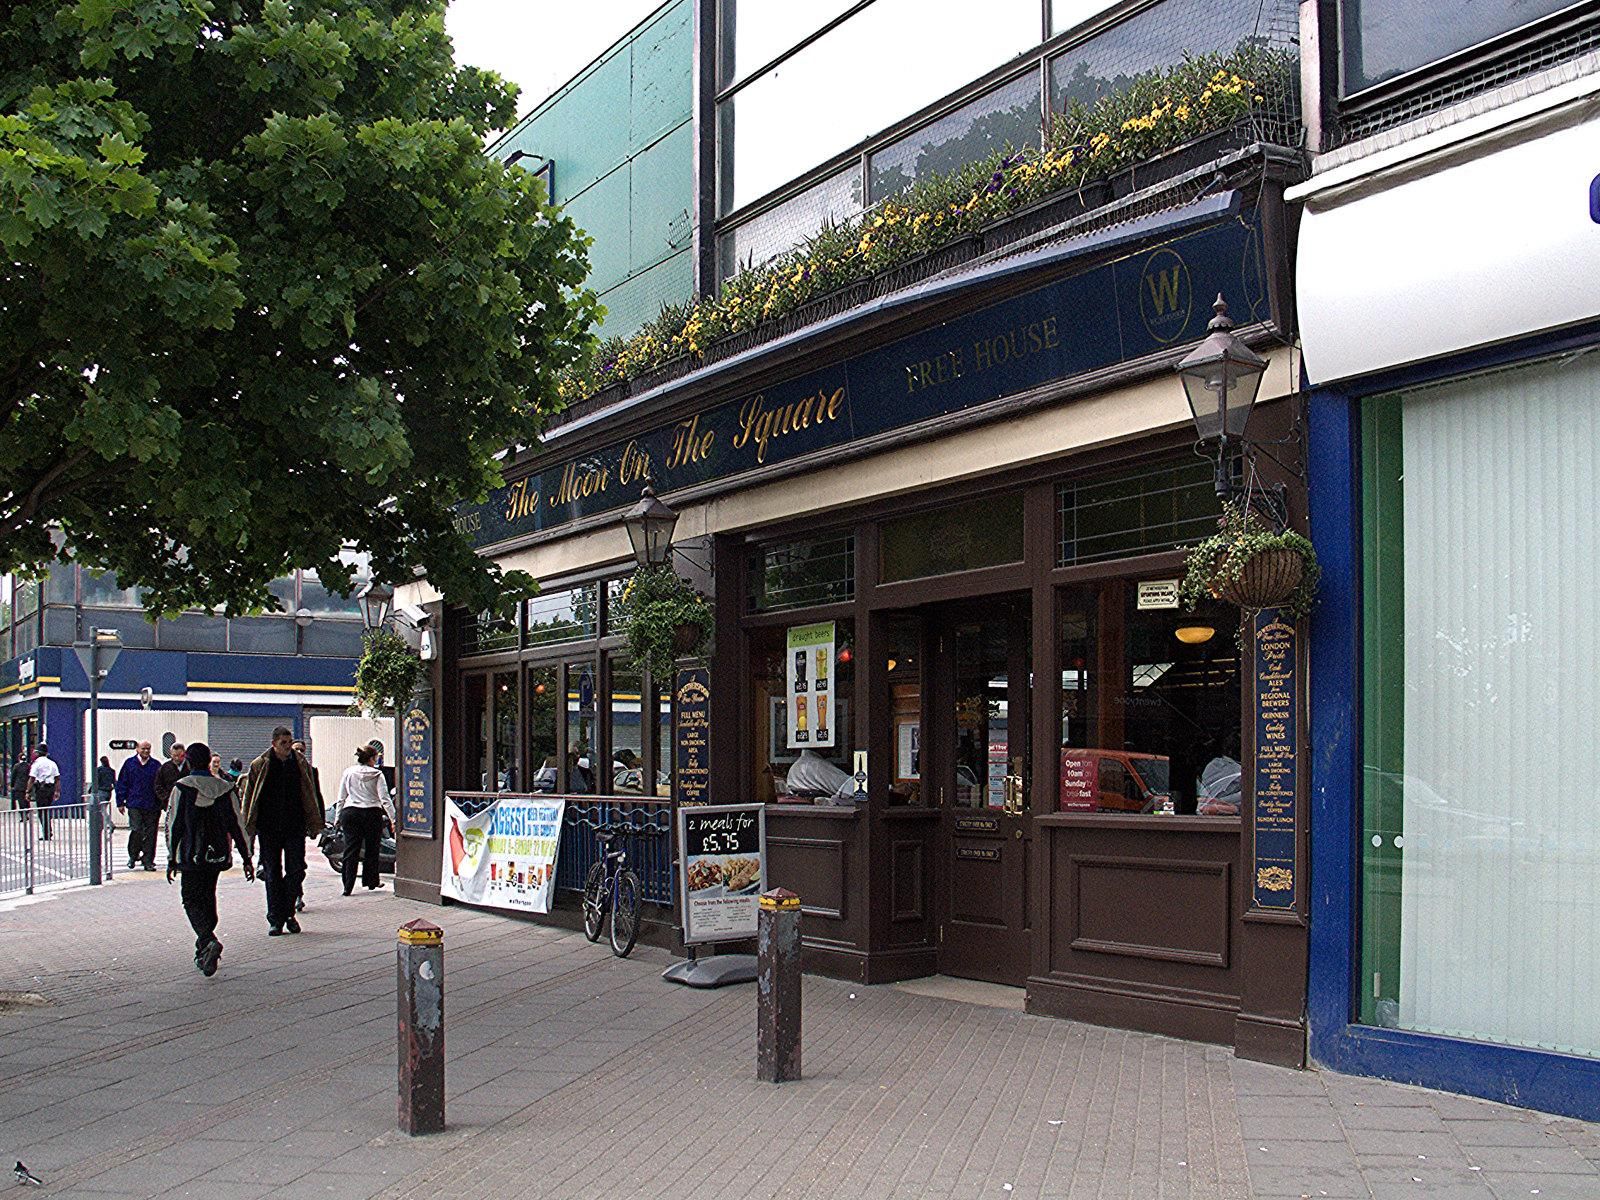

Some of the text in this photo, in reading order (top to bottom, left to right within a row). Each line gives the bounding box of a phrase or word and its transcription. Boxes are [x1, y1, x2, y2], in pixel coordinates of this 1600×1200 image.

[906, 316, 1060, 393] FREE HOUSE
[505, 394, 845, 521] The Moon On The Square
[1261, 642, 1291, 651] LONDON
[1066, 760, 1081, 768] Open
[1065, 780, 1086, 788] Sunday
[689, 813, 754, 831] 2 meals for
[703, 832, 739, 851] £5.75
